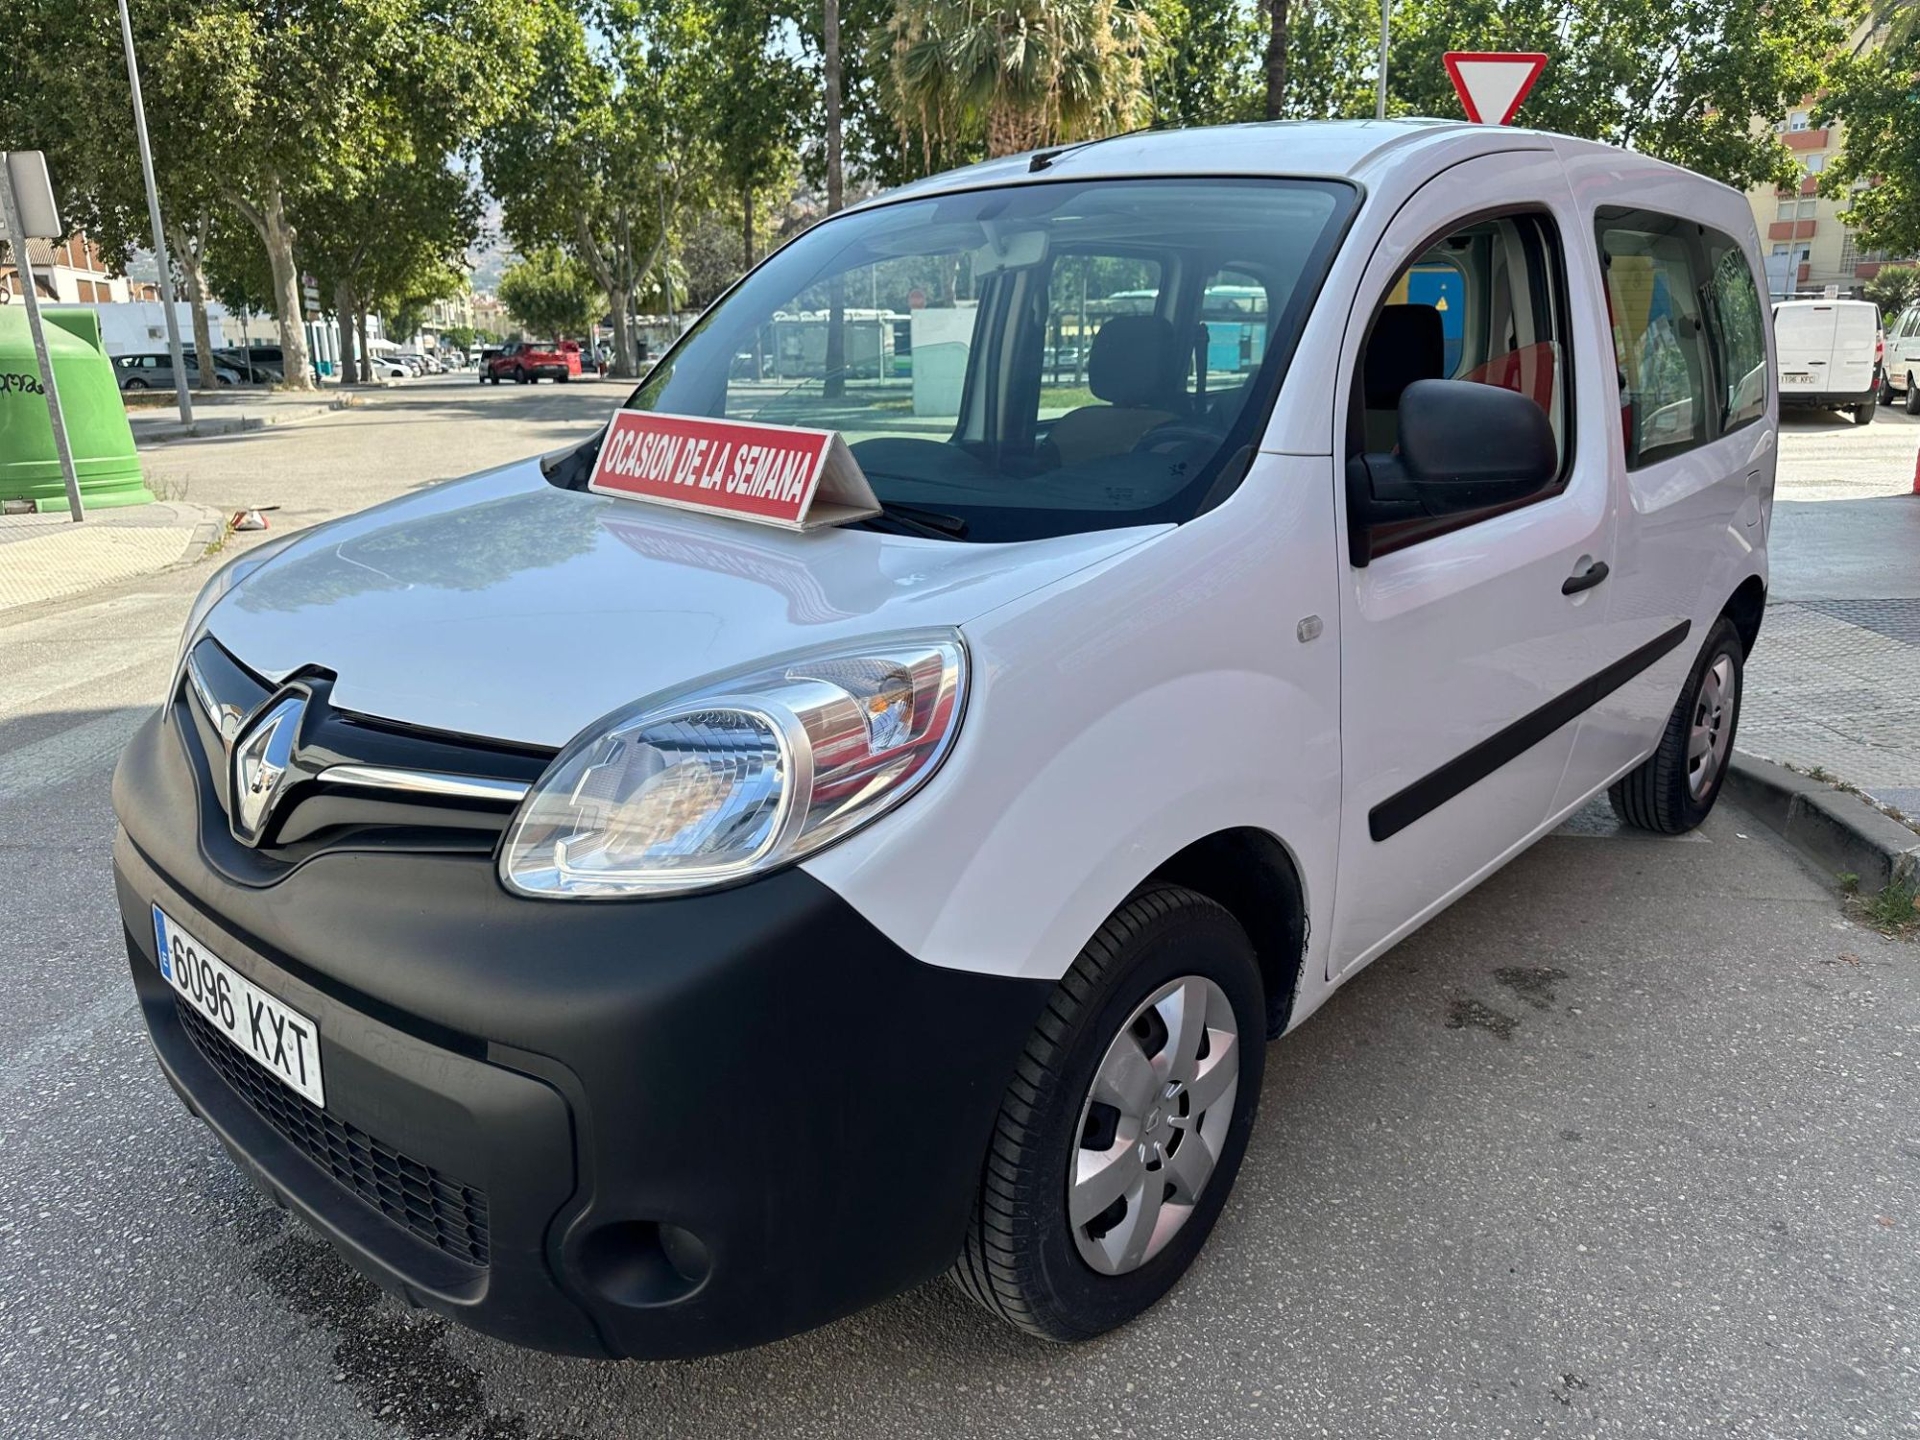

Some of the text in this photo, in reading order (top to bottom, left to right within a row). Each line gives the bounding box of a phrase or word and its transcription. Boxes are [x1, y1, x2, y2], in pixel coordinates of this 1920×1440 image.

[604, 428, 812, 504] OCASION DE LA SEMANA
[161, 950, 169, 968] E
[172, 934, 308, 1086] 6096 KXT
